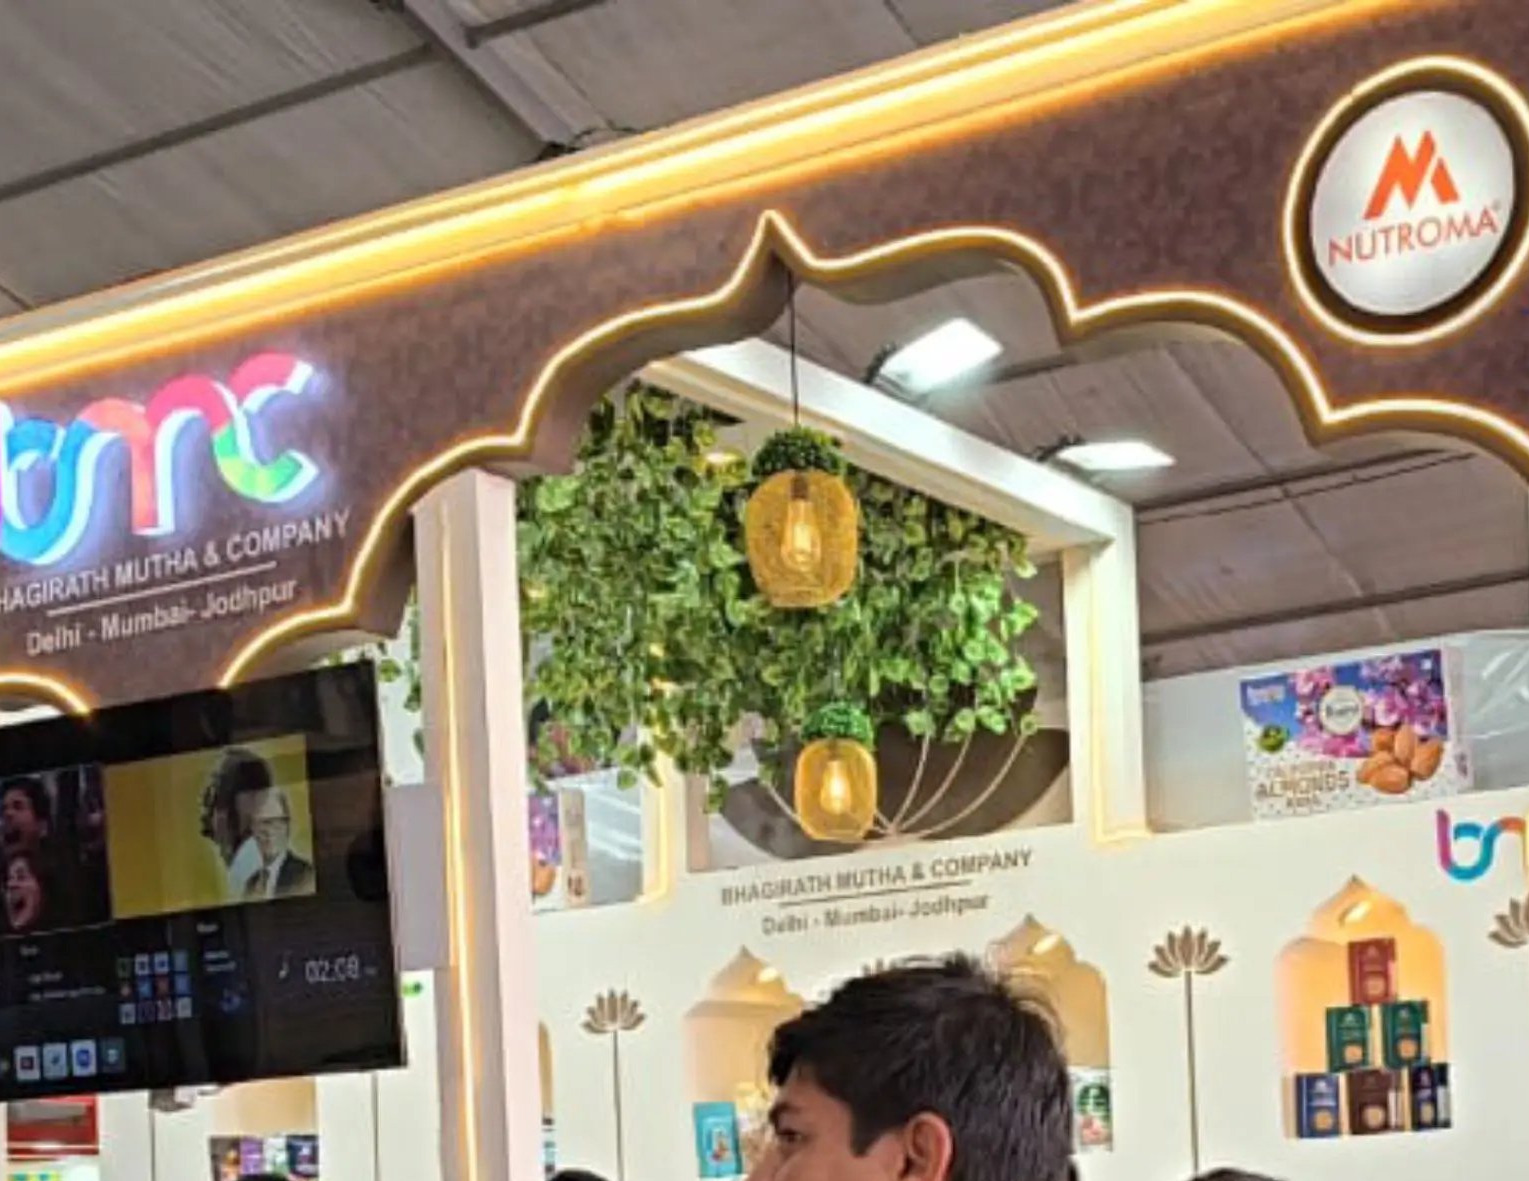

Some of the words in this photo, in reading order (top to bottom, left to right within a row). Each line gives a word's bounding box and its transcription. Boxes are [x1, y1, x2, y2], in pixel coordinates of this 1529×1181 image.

[116, 548, 198, 588] MUTHA
[202, 543, 220, 567] &
[226, 507, 351, 562] COMPANY
[27, 623, 82, 656] Delhi
[201, 581, 299, 619] Jodhpur
[721, 875, 831, 906] BHAGIRATH
[836, 865, 907, 891] MUTHA
[911, 862, 925, 880] &
[930, 849, 1033, 877] COMPANY
[762, 914, 808, 936] Delhi
[908, 893, 990, 918] Jodhpur
